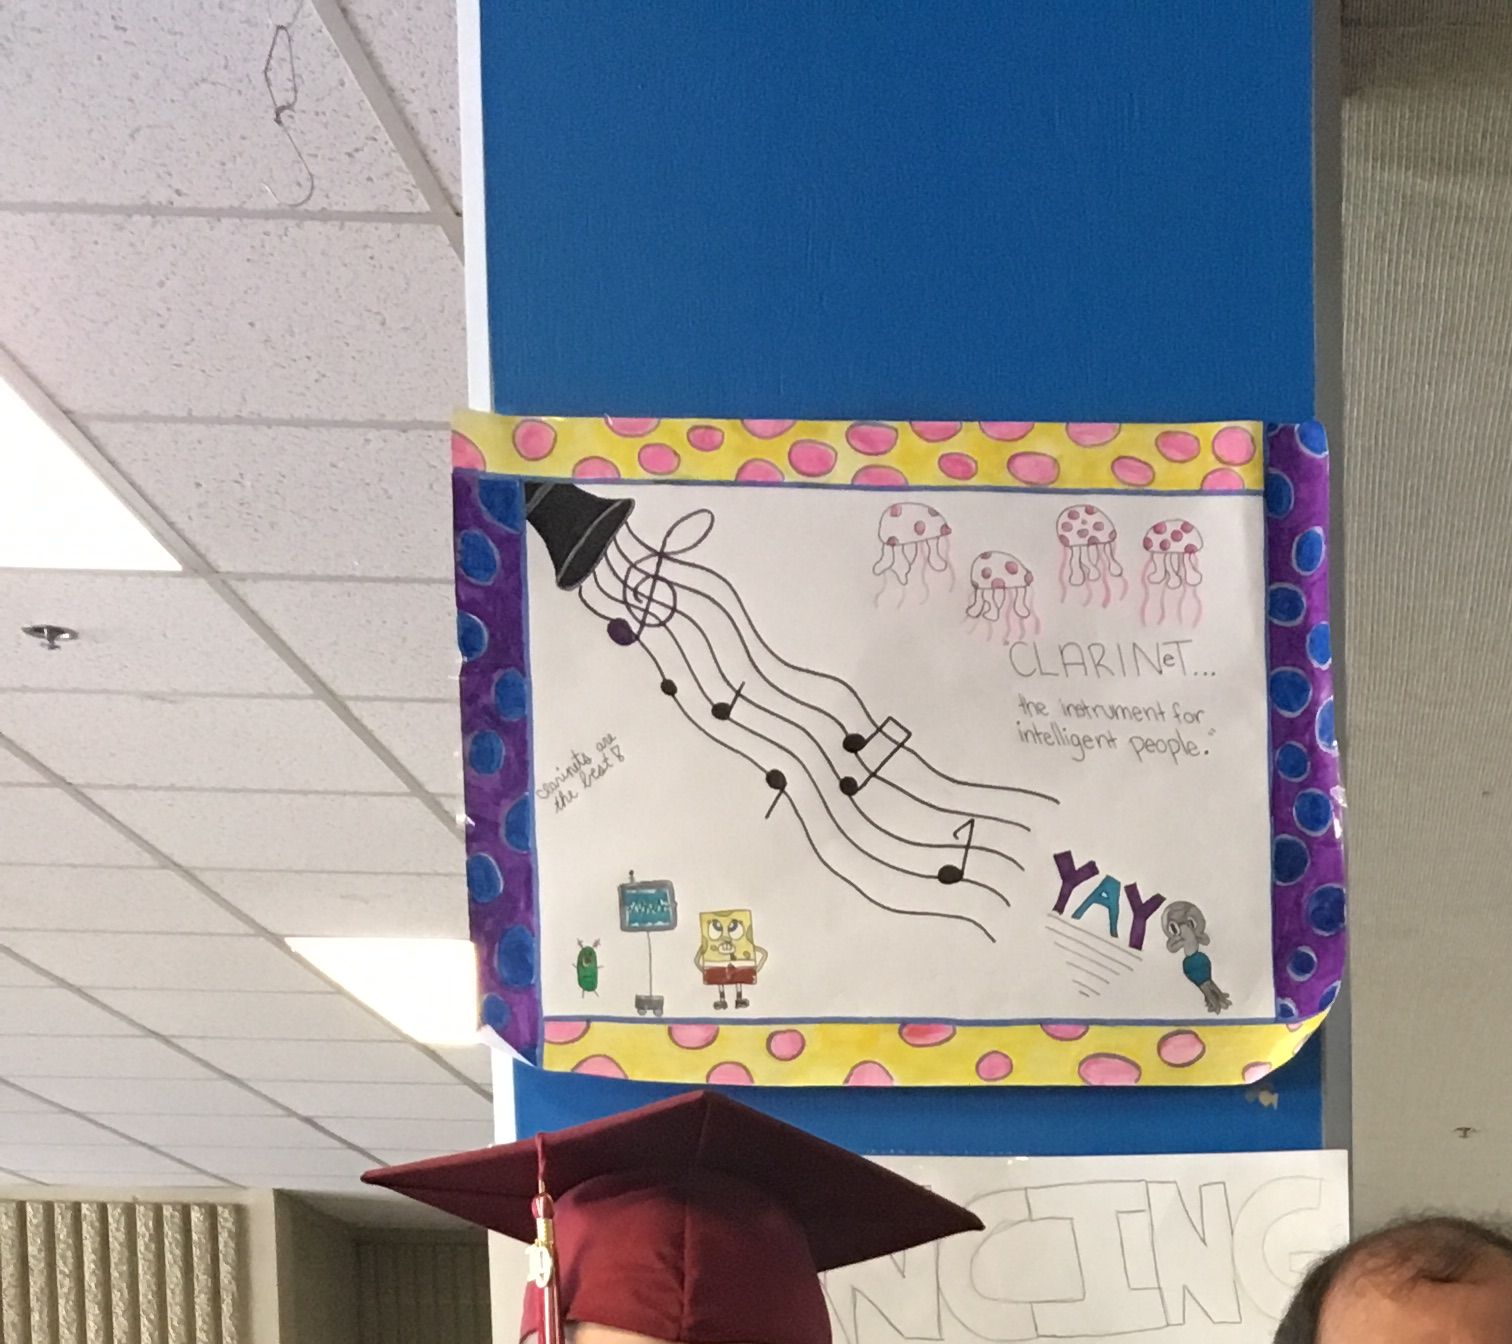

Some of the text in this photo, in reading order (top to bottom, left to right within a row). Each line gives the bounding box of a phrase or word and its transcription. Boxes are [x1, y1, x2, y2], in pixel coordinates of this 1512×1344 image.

[1018, 693, 1205, 724] the instrument for
[596, 733, 617, 752] are
[1016, 720, 1118, 762] intelligent
[553, 790, 579, 814] the
[1052, 849, 1167, 951] YAY
